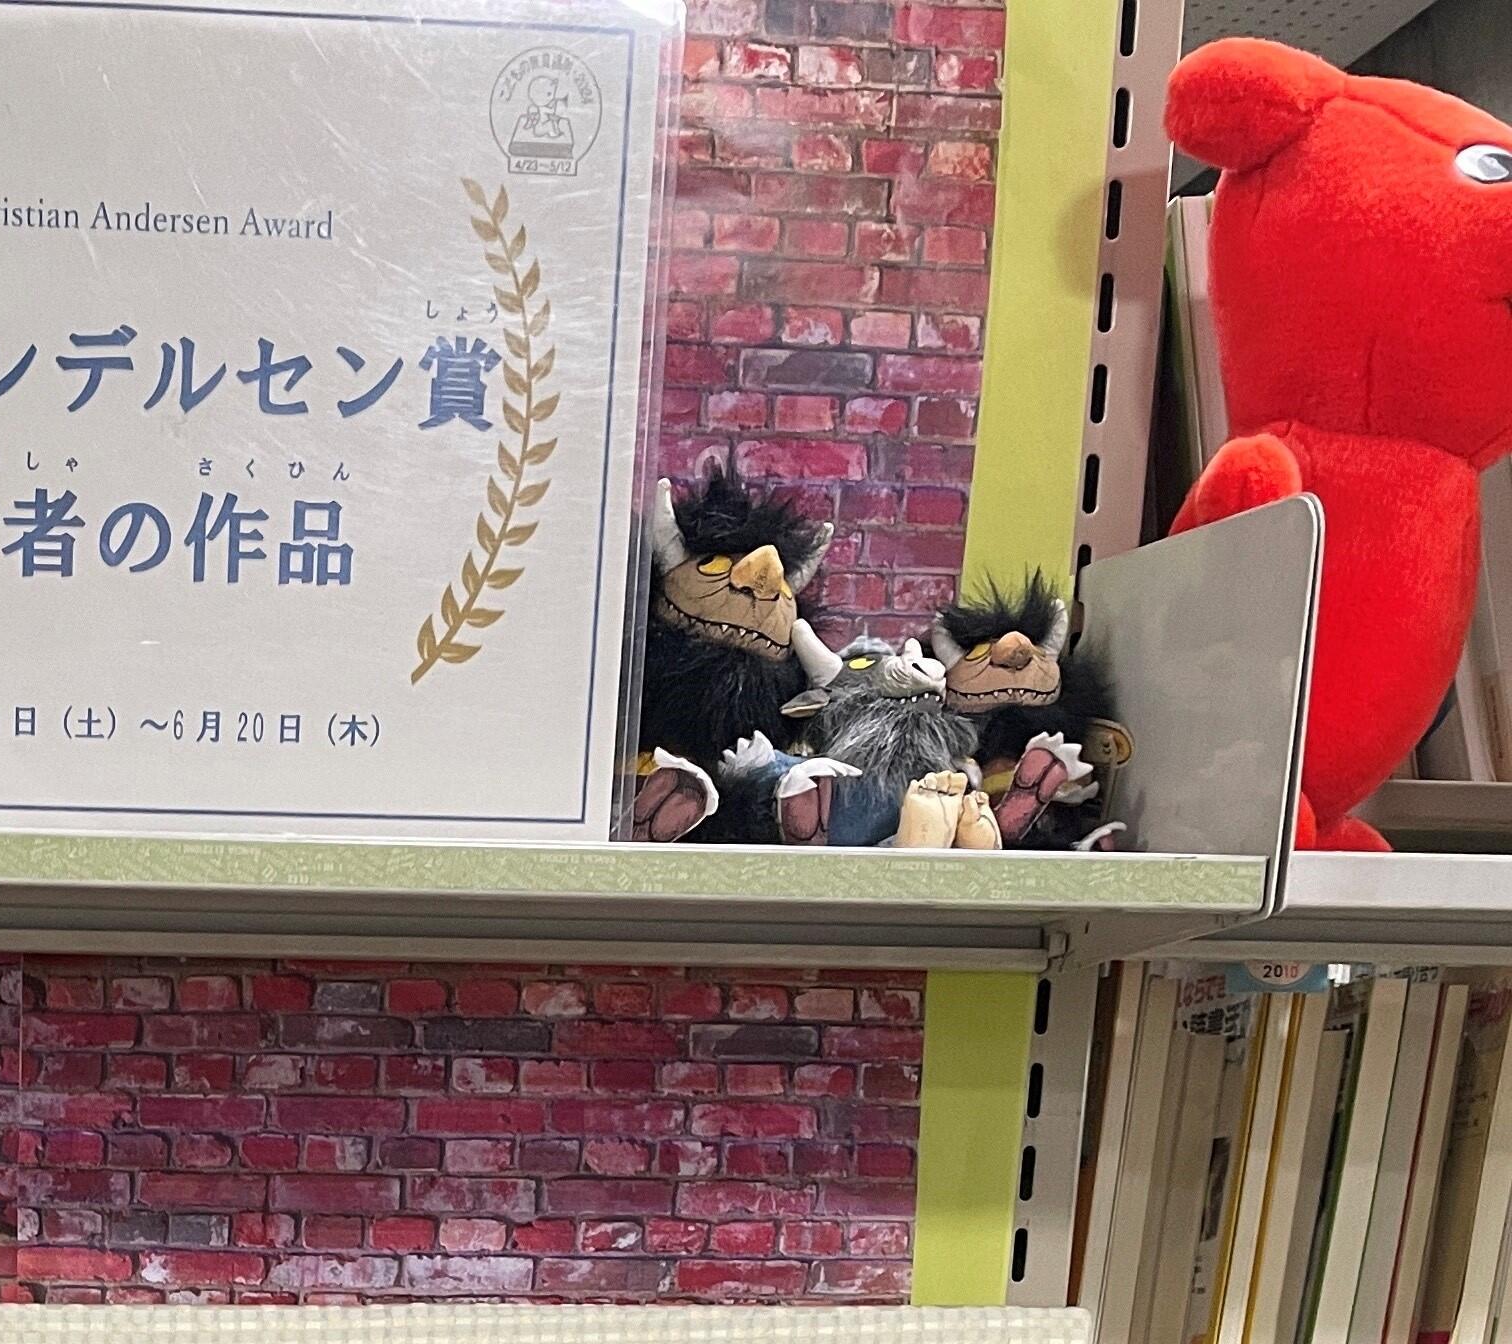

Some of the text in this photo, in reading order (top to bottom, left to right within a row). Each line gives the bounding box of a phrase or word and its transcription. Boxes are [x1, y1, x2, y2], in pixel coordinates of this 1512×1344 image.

[91, 199, 230, 238] Andersen
[239, 206, 334, 242] Award
[424, 300, 501, 324] しょう
[197, 458, 352, 481] さくひん
[1263, 964, 1299, 979] 2010
